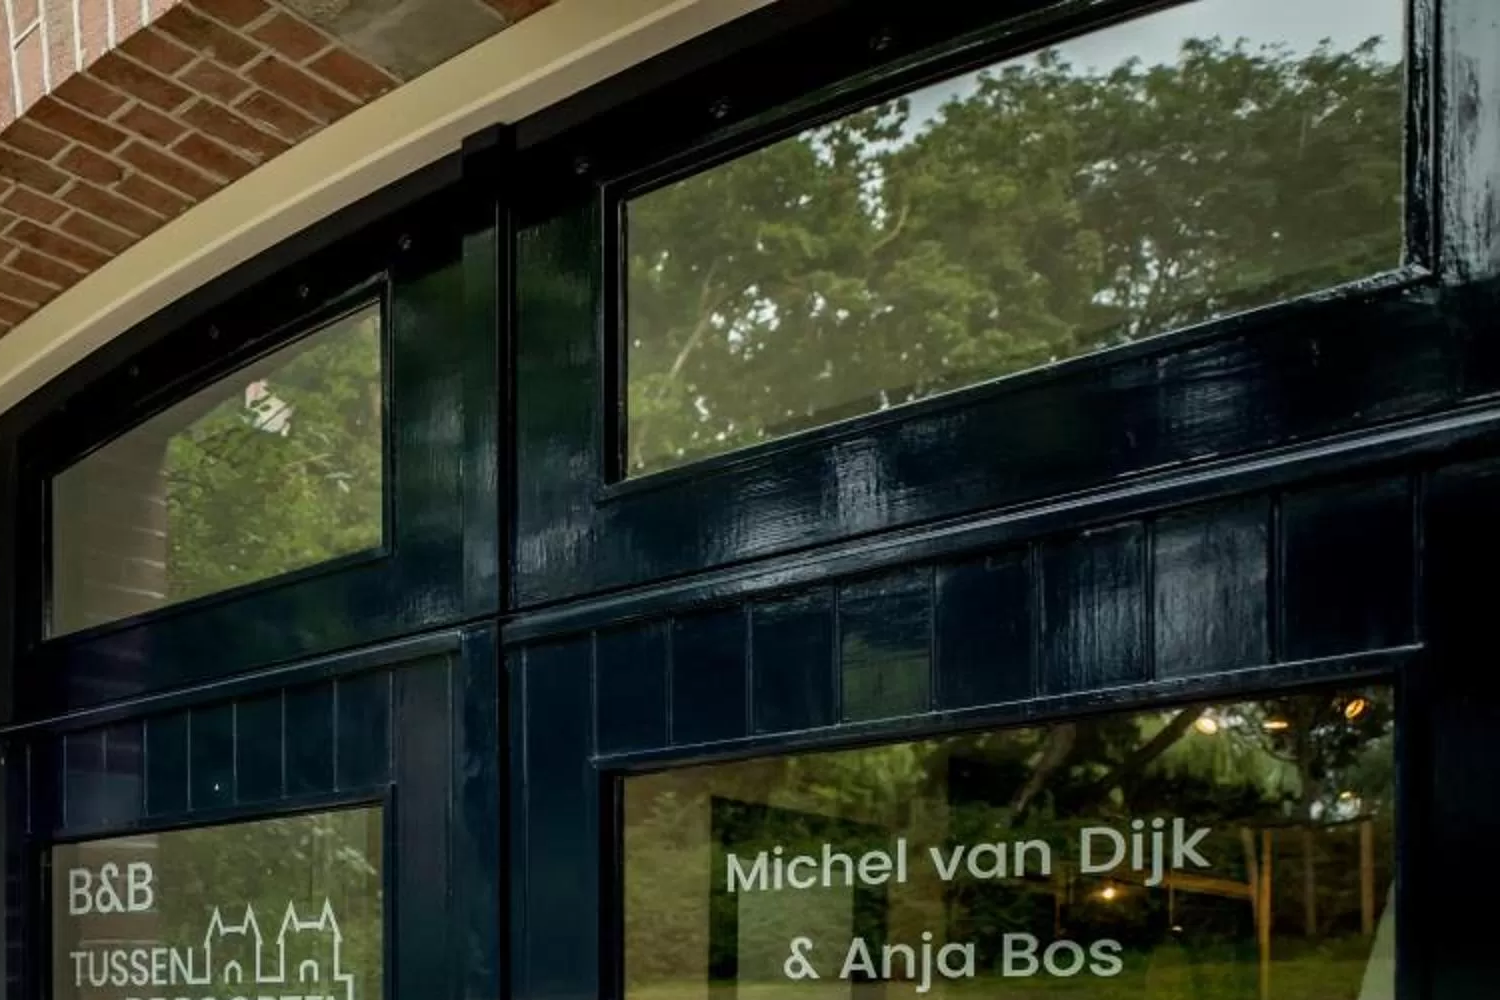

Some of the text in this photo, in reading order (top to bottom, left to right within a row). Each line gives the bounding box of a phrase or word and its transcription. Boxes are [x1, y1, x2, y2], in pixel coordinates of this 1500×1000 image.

[726, 816, 1211, 892] Michel van Dijk
[68, 861, 154, 915] B&B
[70, 947, 193, 986] TUSSEN
[783, 931, 1123, 992] & Anja Bos
